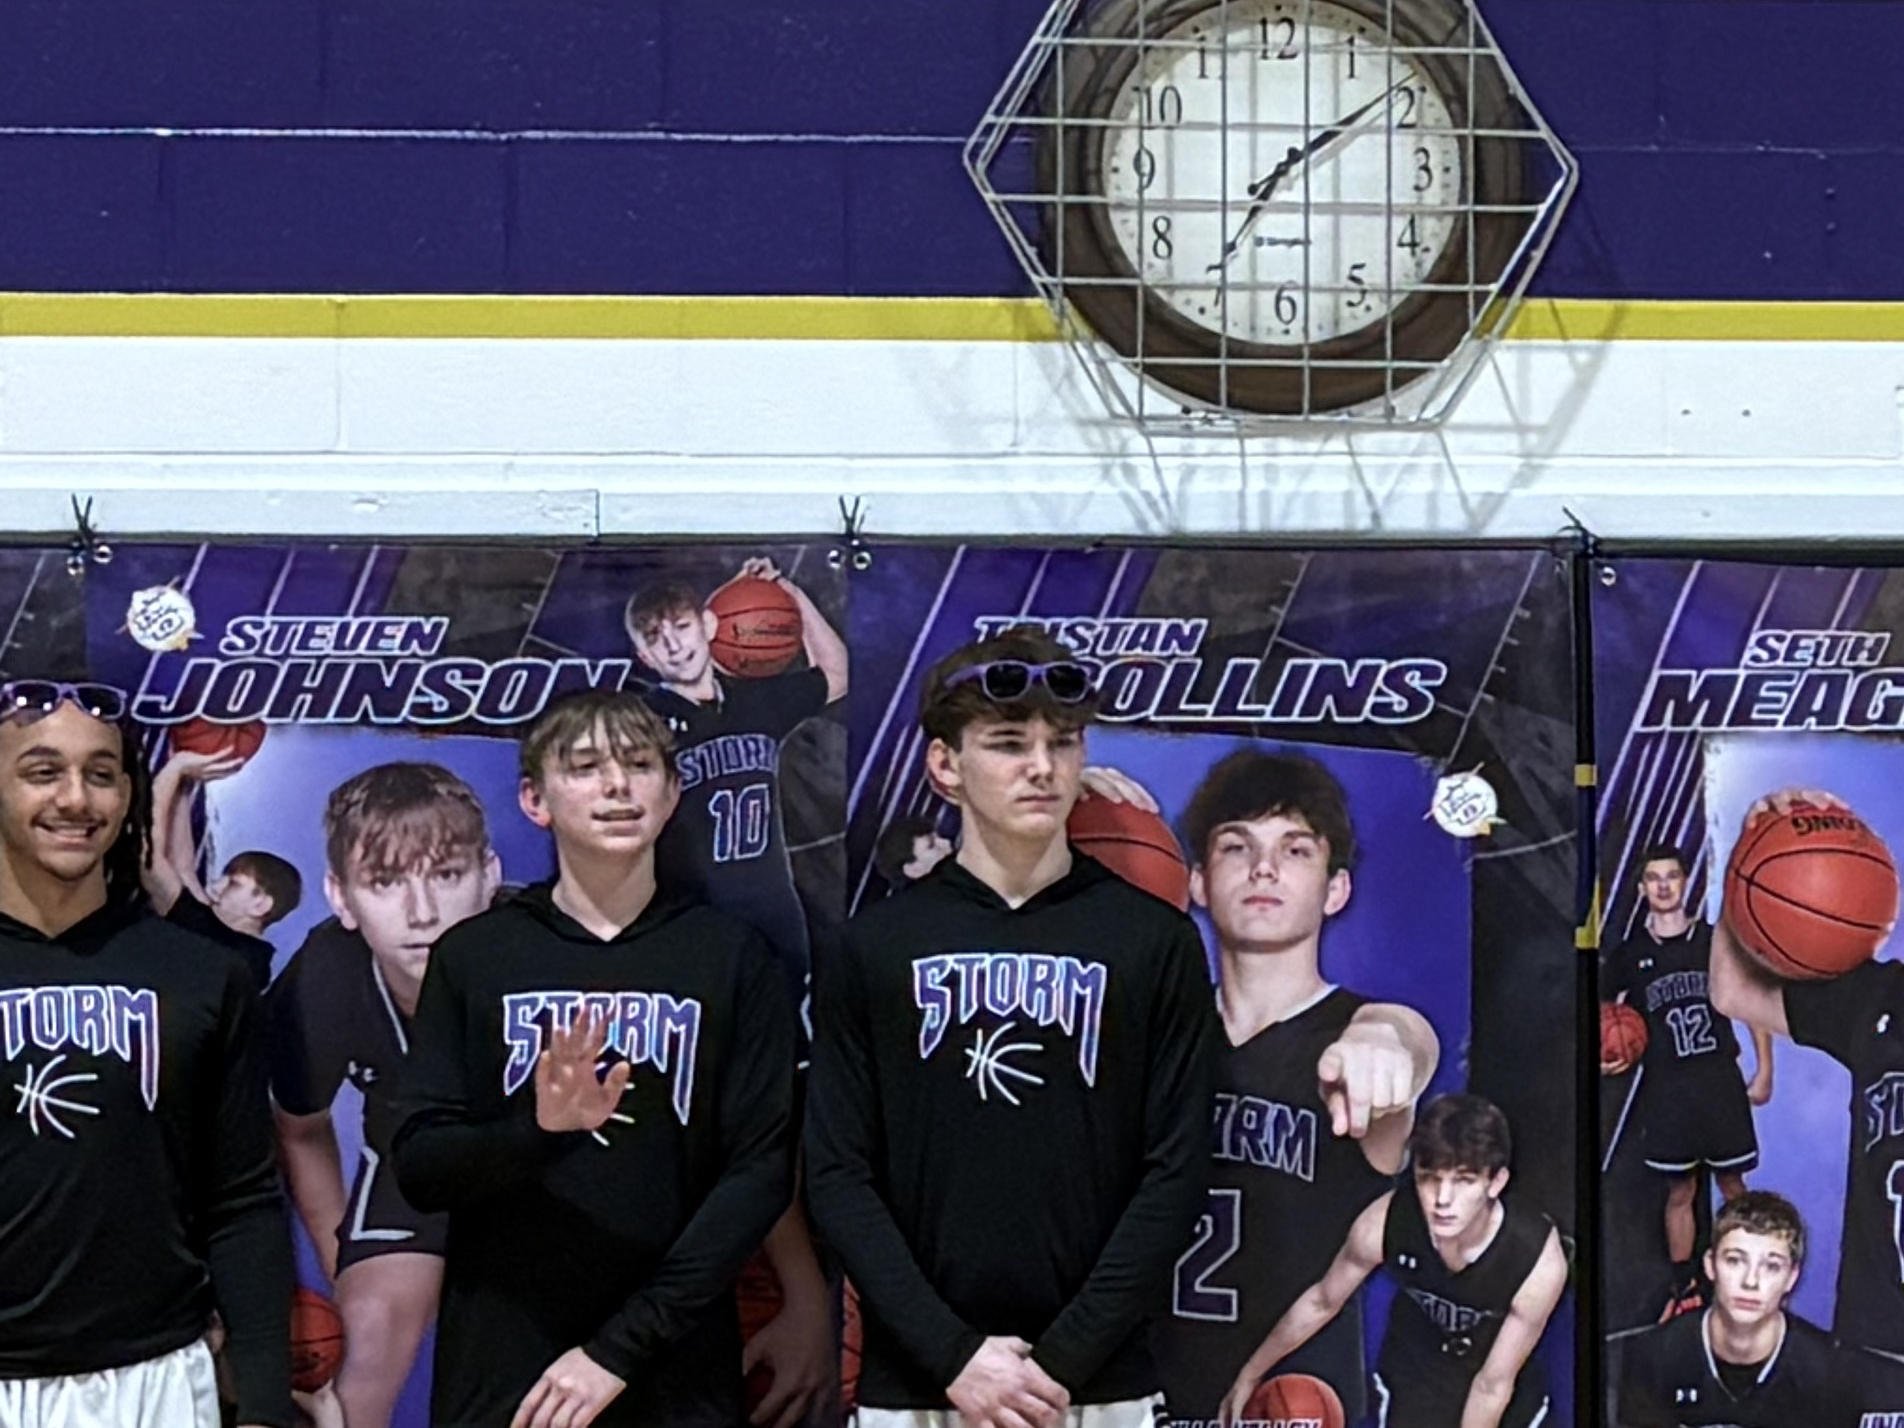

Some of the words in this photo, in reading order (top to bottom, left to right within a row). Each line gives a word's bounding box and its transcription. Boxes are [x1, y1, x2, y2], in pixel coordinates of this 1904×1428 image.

[1261, 16, 1299, 60] 12
[1143, 85, 1183, 130] 10
[1396, 86, 1417, 129] 2
[1132, 147, 1156, 191] 9
[1413, 147, 1434, 193] 3
[1153, 216, 1173, 259] 8
[1397, 213, 1421, 258] 4
[1275, 280, 1298, 326] 6
[1346, 263, 1367, 308] 5
[220, 616, 449, 656] STEVEN
[975, 616, 1208, 657] TSTAN
[1743, 629, 1892, 668] SETH
[1080, 659, 1447, 724] OLLINS
[708, 783, 770, 863] 10
[912, 952, 1108, 1089] STORM
[1665, 1004, 1718, 1058] 12
[0, 985, 160, 1112] TORM
